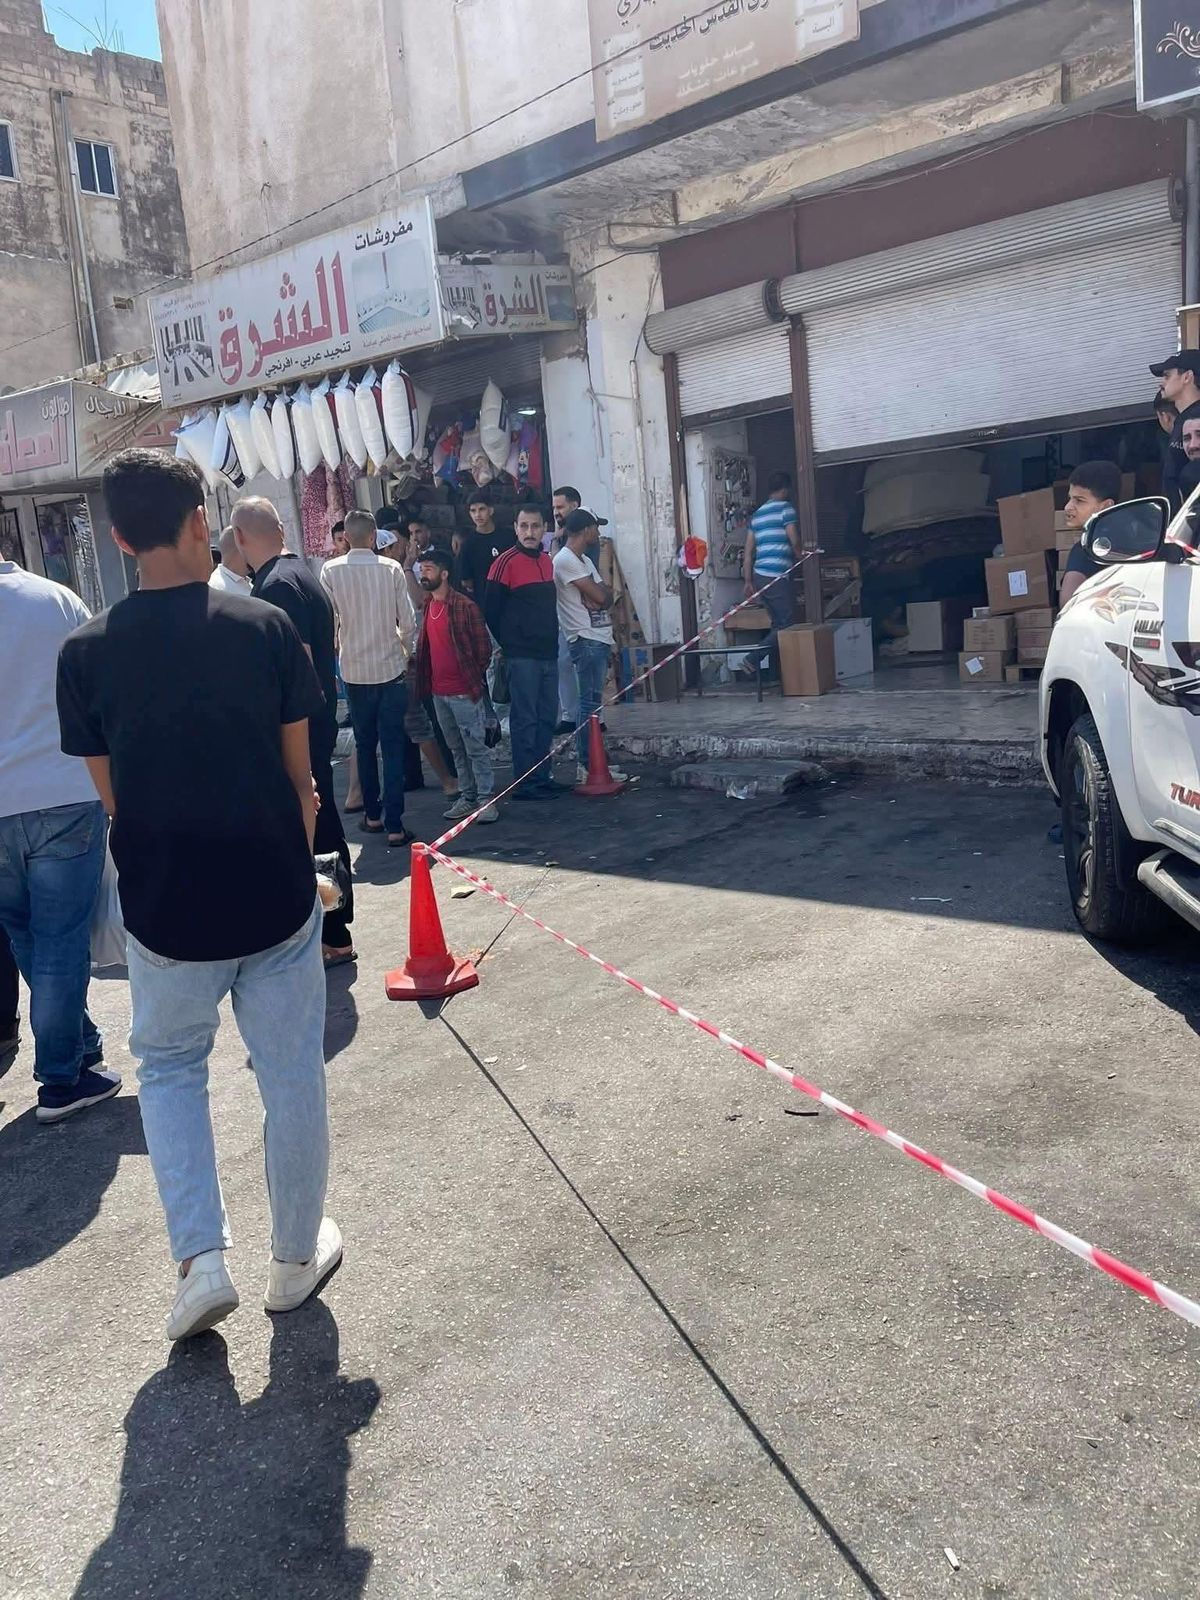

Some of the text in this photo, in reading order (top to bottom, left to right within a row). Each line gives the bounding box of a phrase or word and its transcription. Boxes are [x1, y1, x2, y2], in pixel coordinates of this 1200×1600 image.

[354, 219, 413, 251] مفروشات
[484, 273, 546, 327] الشرق
[217, 250, 350, 386] الشرق
[300, 352, 321, 369] عربي
[323, 340, 351, 360] تنجيد
[41, 395, 70, 422] صالون
